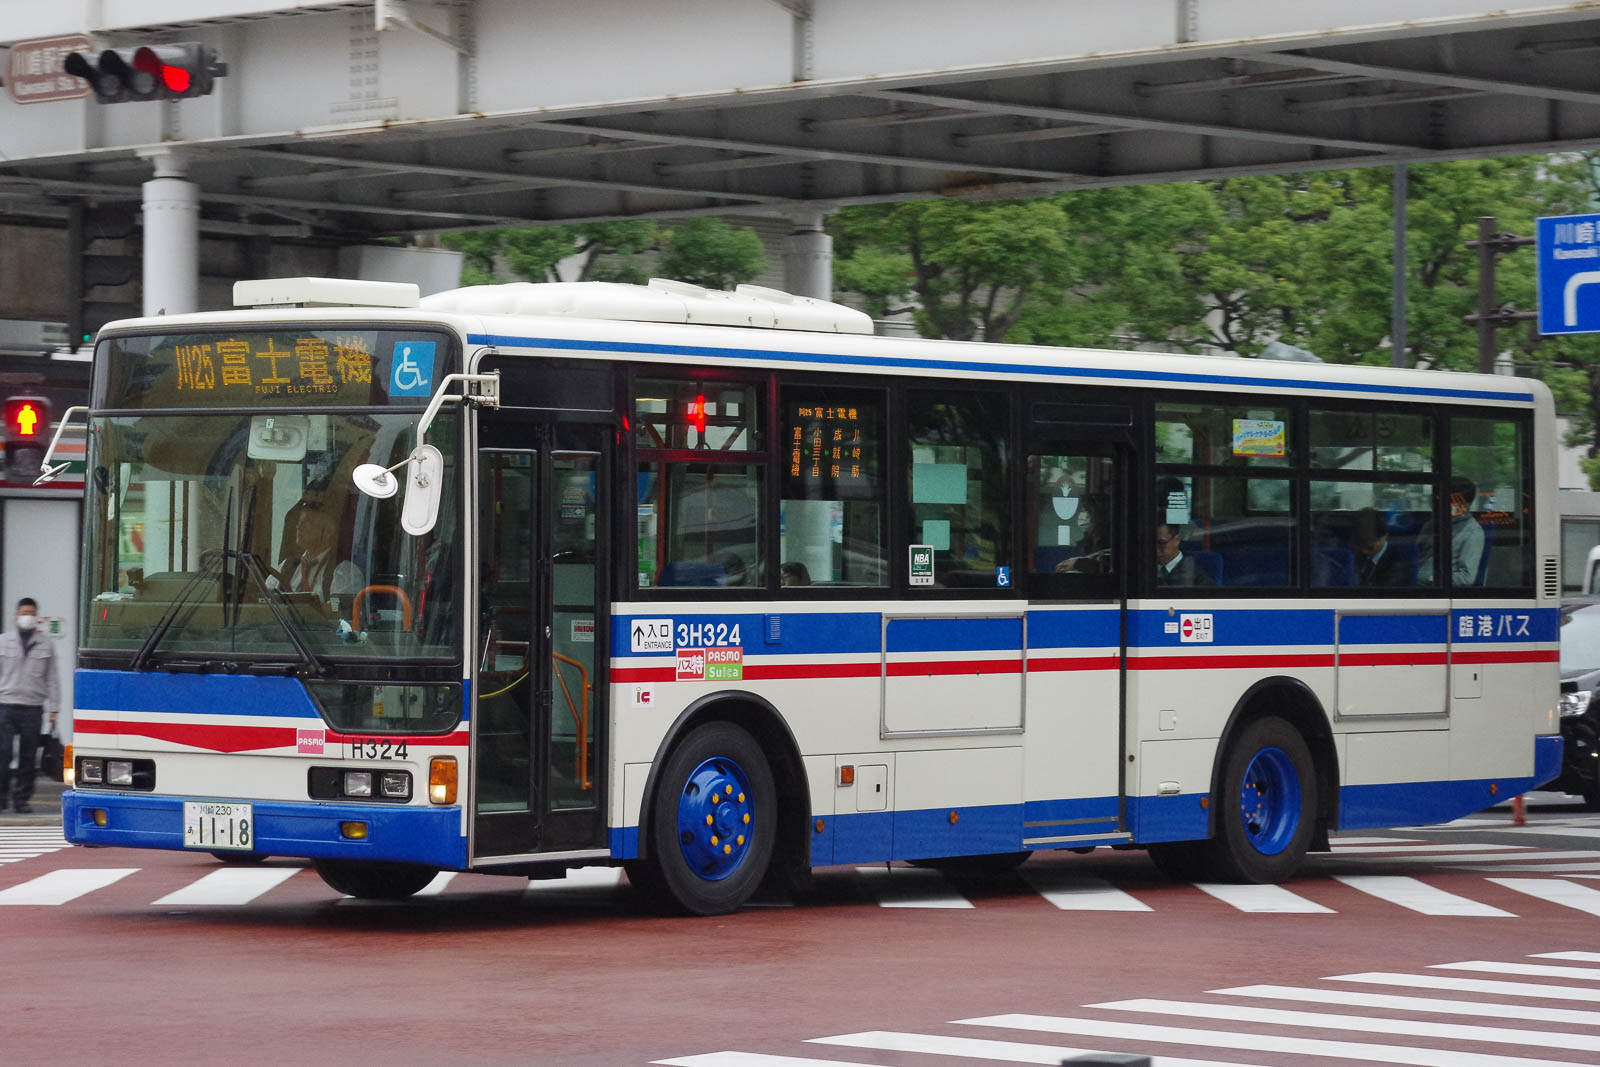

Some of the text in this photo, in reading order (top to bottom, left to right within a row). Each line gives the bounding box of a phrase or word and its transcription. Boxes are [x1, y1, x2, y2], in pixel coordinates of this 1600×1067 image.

[1554, 221, 1600, 245] 川崎
[216, 336, 372, 385] 富士電機
[255, 384, 338, 394] FUJI ELECTRIC
[914, 553, 930, 564] NBA
[1194, 617, 1211, 630] 出口
[1459, 615, 1530, 637] 臨港バス
[647, 624, 669, 639] 入口
[677, 623, 741, 646] 3H324
[1196, 632, 1209, 640] EXIT
[644, 641, 672, 649] ENTRANCE
[707, 651, 740, 662] PASMO
[709, 667, 739, 678] Suica
[298, 738, 324, 747] PASMO
[352, 738, 408, 760] H324
[215, 805, 232, 816] 230
